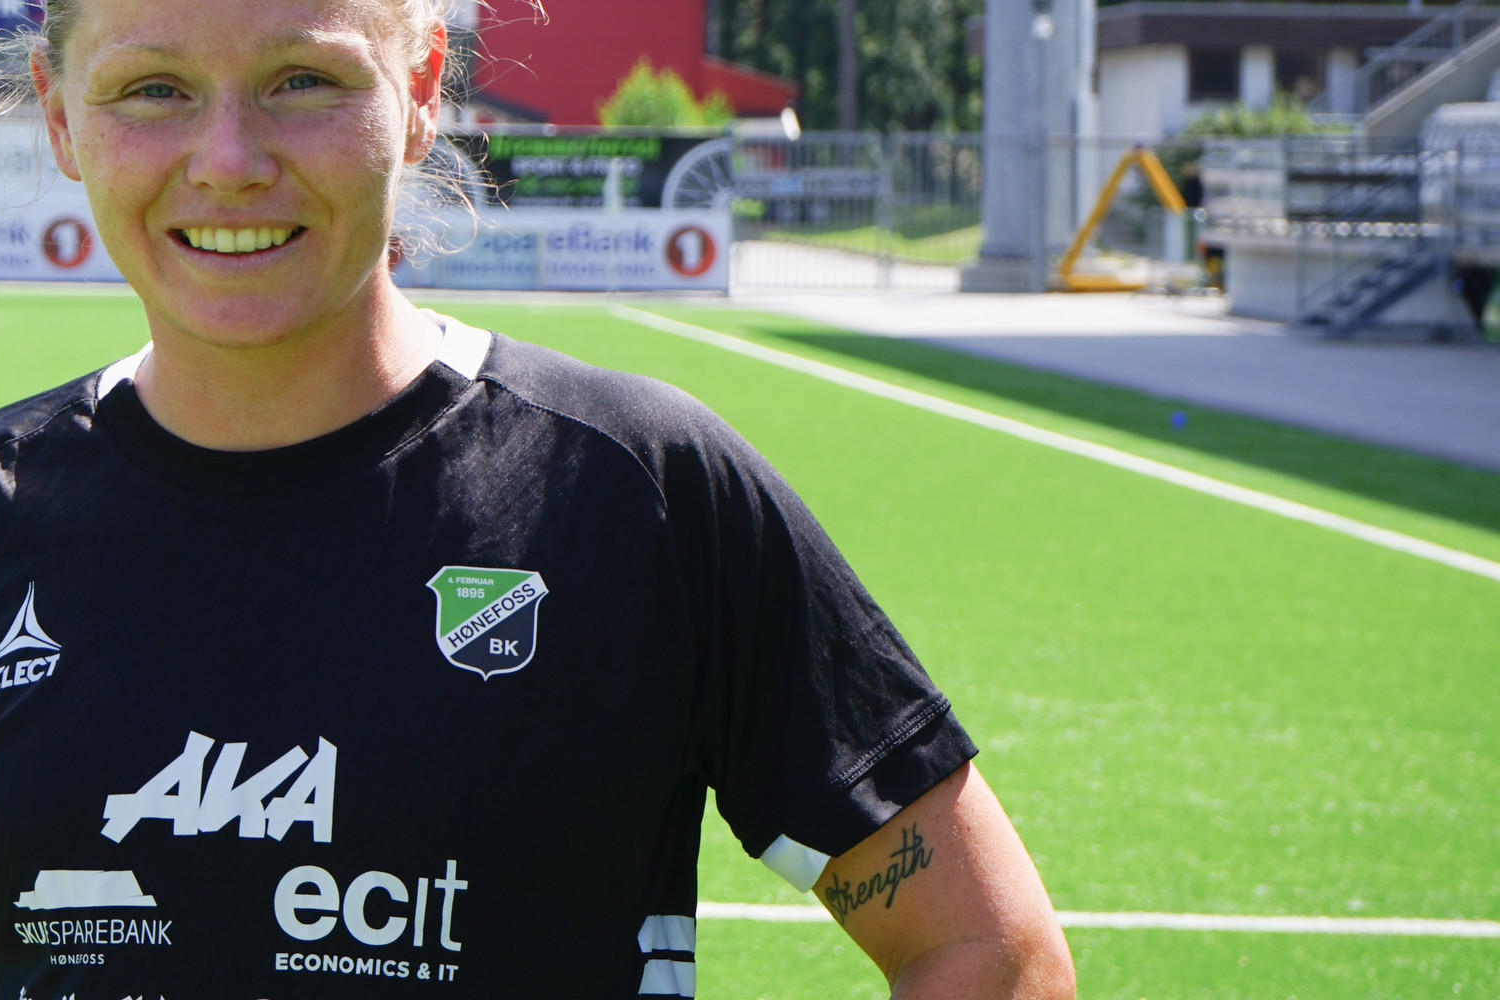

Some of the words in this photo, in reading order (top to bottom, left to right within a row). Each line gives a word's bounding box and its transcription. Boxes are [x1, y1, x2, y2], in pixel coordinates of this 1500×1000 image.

[456, 577, 494, 586] FEBRUAR
[456, 588, 485, 599] 1895
[448, 583, 536, 648] HØNEFOSS
[489, 638, 519, 657] BK
[101, 730, 338, 844] AKA
[50, 919, 172, 945] SPAREBANK
[51, 954, 105, 965] HØNEFOSS
[275, 952, 409, 978] ECONOMICS
[416, 963, 431, 980] &
[438, 963, 459, 982] IT
